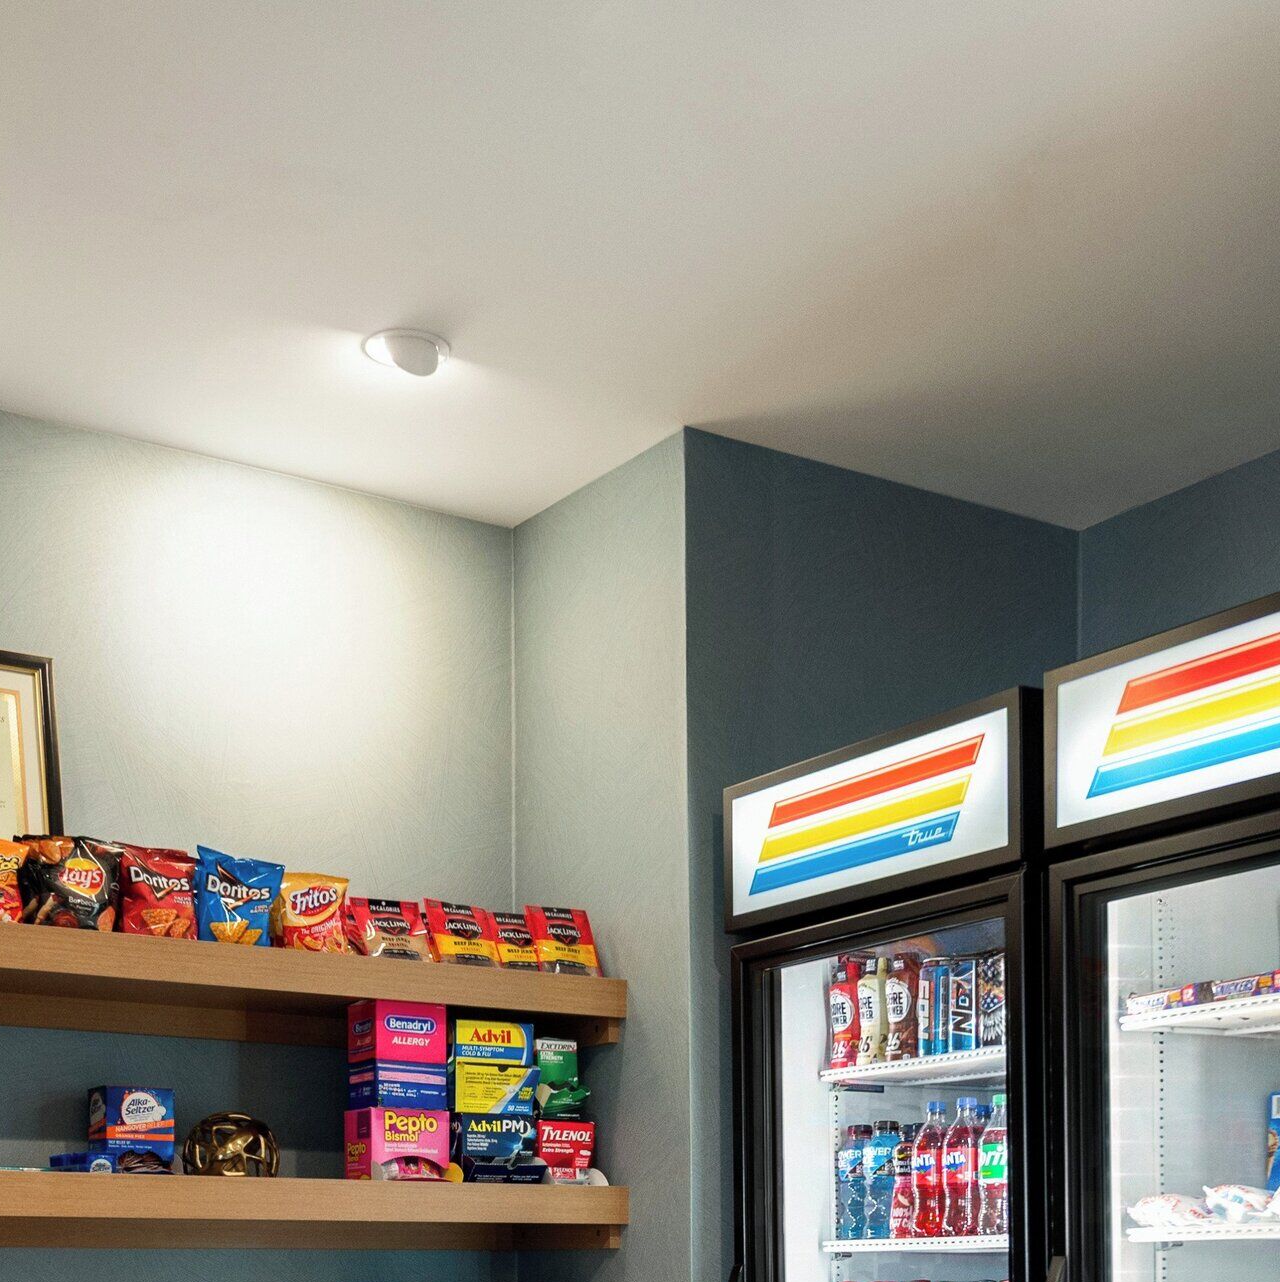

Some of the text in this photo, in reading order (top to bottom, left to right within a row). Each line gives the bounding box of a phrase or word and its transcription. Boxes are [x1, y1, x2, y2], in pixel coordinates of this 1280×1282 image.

[61, 868, 101, 892] Lay's
[129, 866, 191, 893] Doritos
[207, 874, 270, 901] Doritos
[290, 887, 337, 915] Fritos
[445, 921, 462, 930] JACK
[547, 926, 563, 936] JACK
[498, 930, 514, 939] JACK
[390, 1018, 431, 1033] Benadryl
[392, 1036, 430, 1046] ALLERGY
[470, 1028, 512, 1044] Advil
[461, 1045, 505, 1053] MULTI-SYMPTOM
[540, 1042, 576, 1051] EXCEDRIN
[128, 1098, 151, 1107] Alka-
[125, 1105, 156, 1116] Seltzer
[384, 1110, 438, 1133] Pepto
[115, 1124, 146, 1132] HANGOVER
[384, 1131, 419, 1142] Bismol
[541, 1126, 591, 1142] TYLENOL
